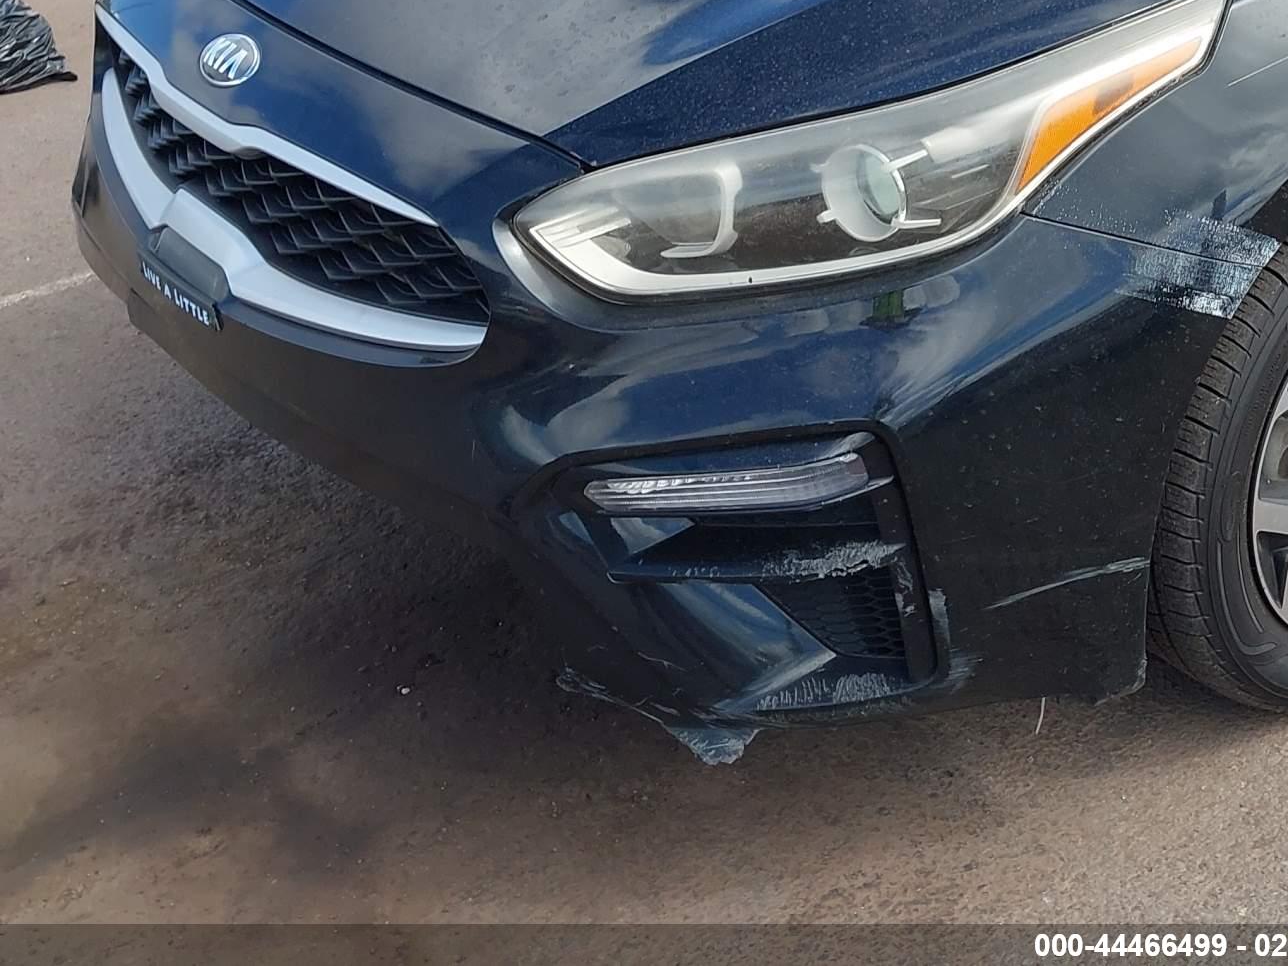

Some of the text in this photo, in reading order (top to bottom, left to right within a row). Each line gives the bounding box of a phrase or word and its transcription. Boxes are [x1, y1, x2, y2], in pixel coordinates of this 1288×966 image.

[202, 35, 250, 81] KIA
[141, 261, 212, 328] LIVE A LITTLE
